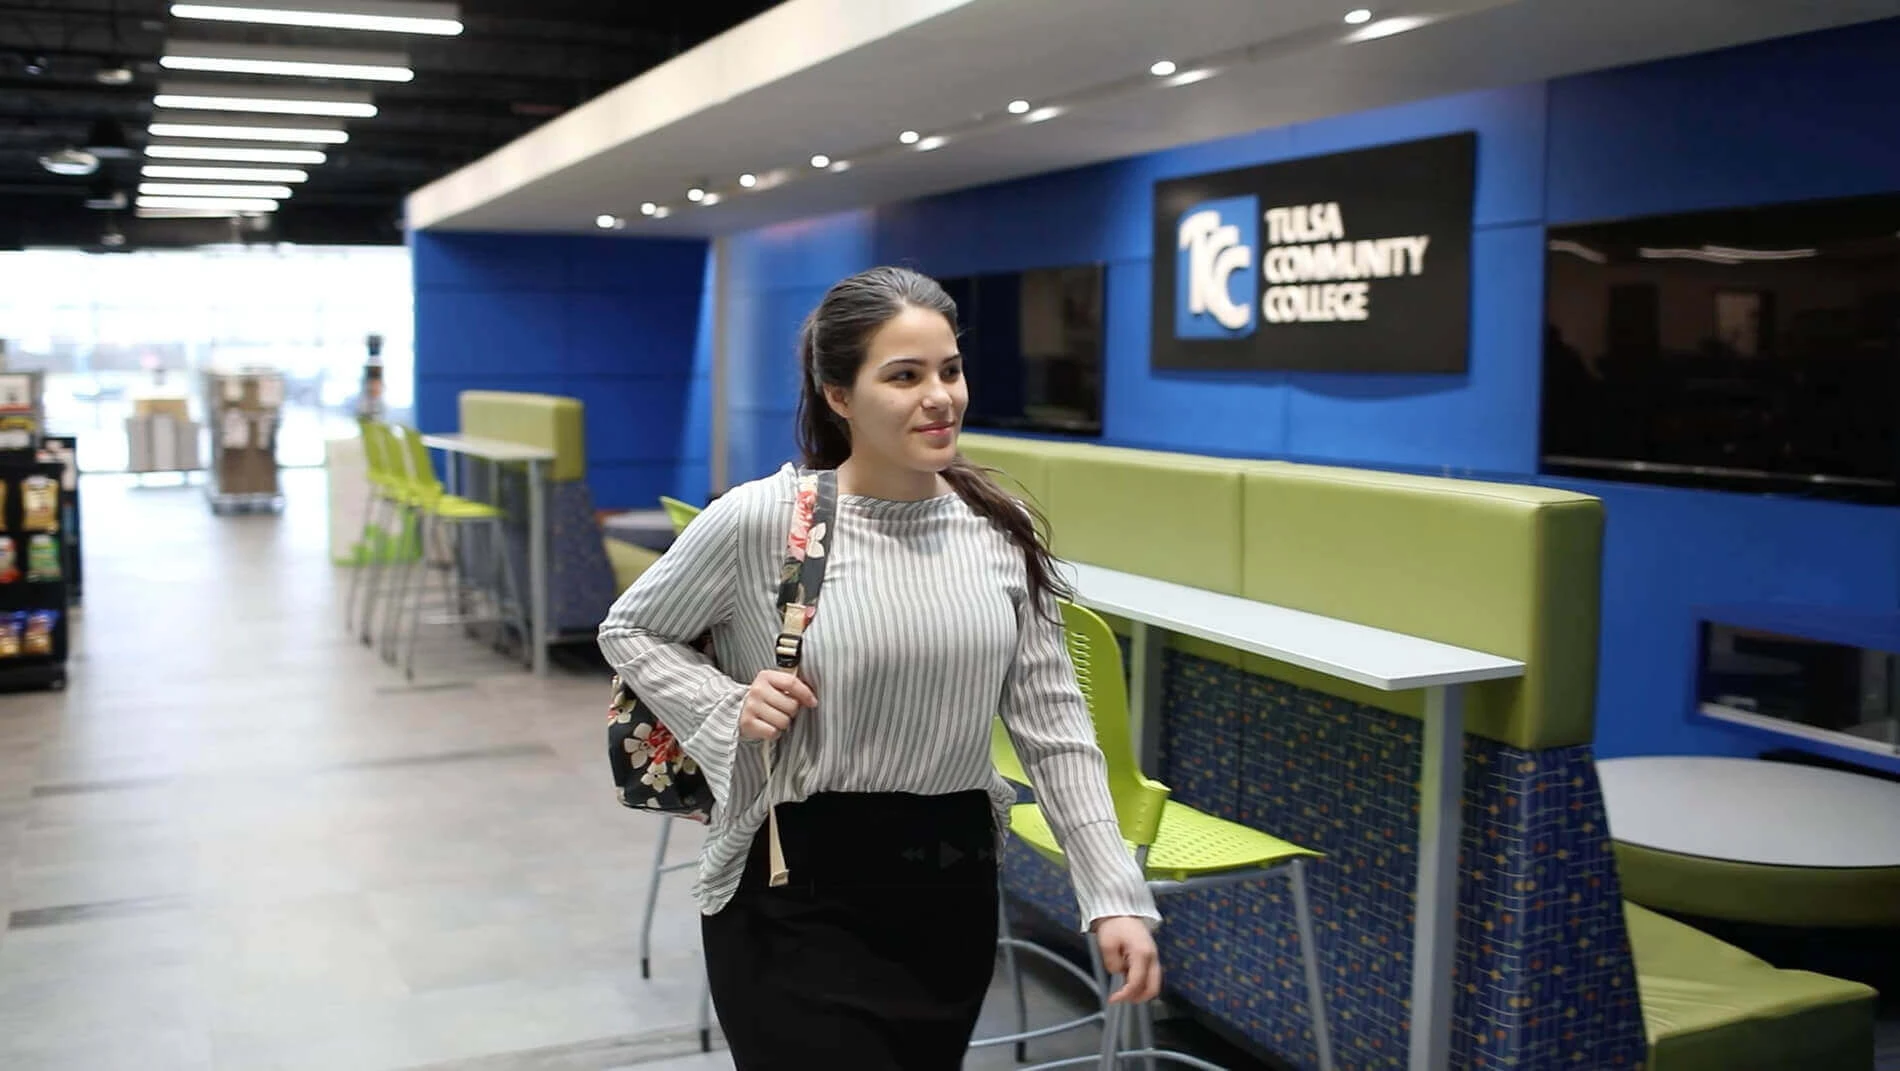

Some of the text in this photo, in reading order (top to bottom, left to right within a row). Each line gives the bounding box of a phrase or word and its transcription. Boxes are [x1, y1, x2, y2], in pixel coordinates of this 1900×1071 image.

[1265, 202, 1344, 244] TULSA
[1179, 210, 1251, 329] TCC
[1263, 236, 1429, 284] COMMUNITY
[1262, 282, 1370, 323] COLLEGE
